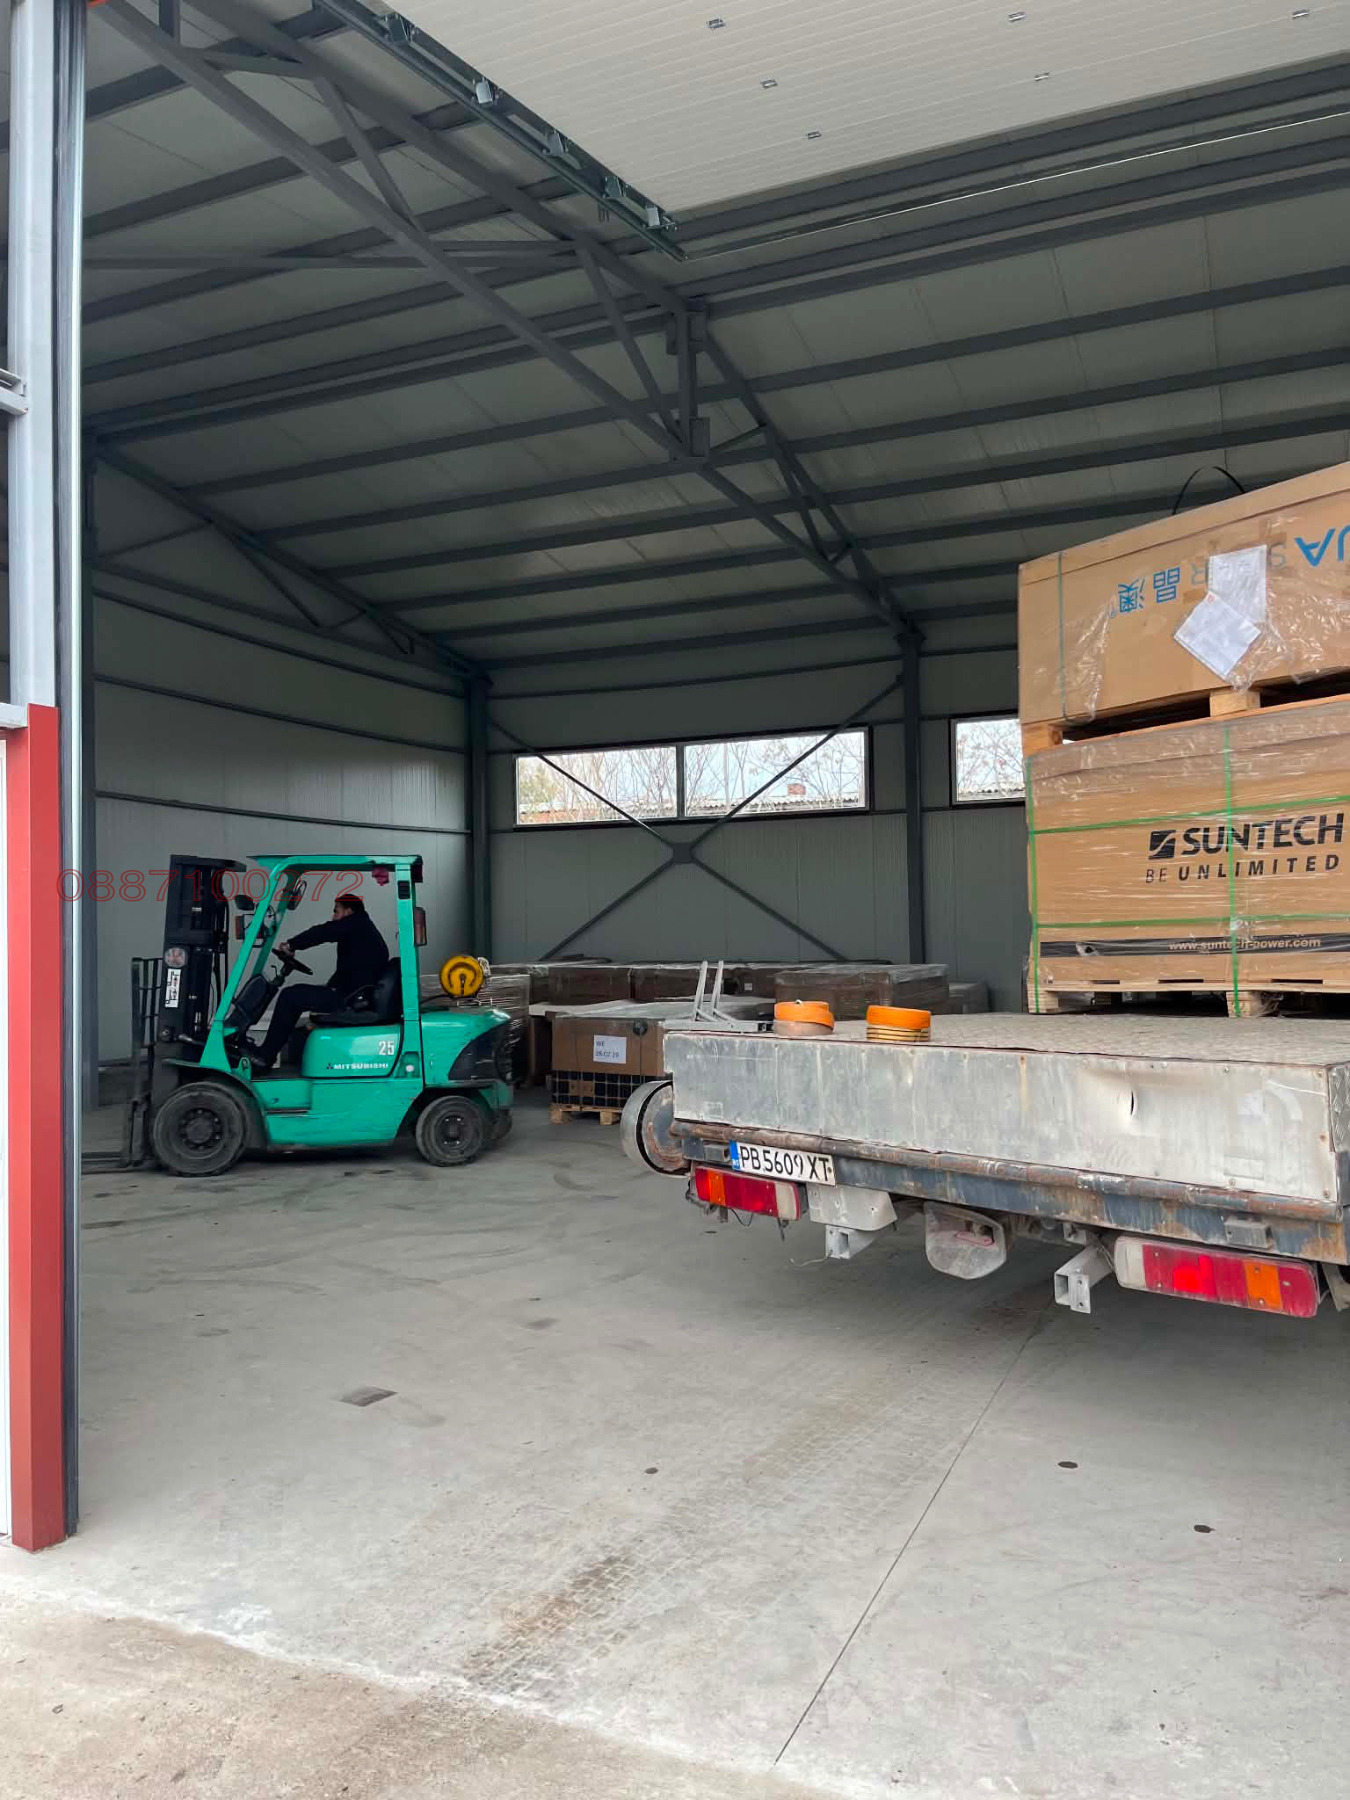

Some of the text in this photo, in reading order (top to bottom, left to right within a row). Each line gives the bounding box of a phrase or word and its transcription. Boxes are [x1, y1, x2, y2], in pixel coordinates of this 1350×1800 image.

[1181, 812, 1344, 856] SUNTECH
[1146, 854, 1340, 884] BE UNLIMITED
[378, 1040, 395, 1056] 25
[333, 1062, 389, 1070] MITSUBISHI
